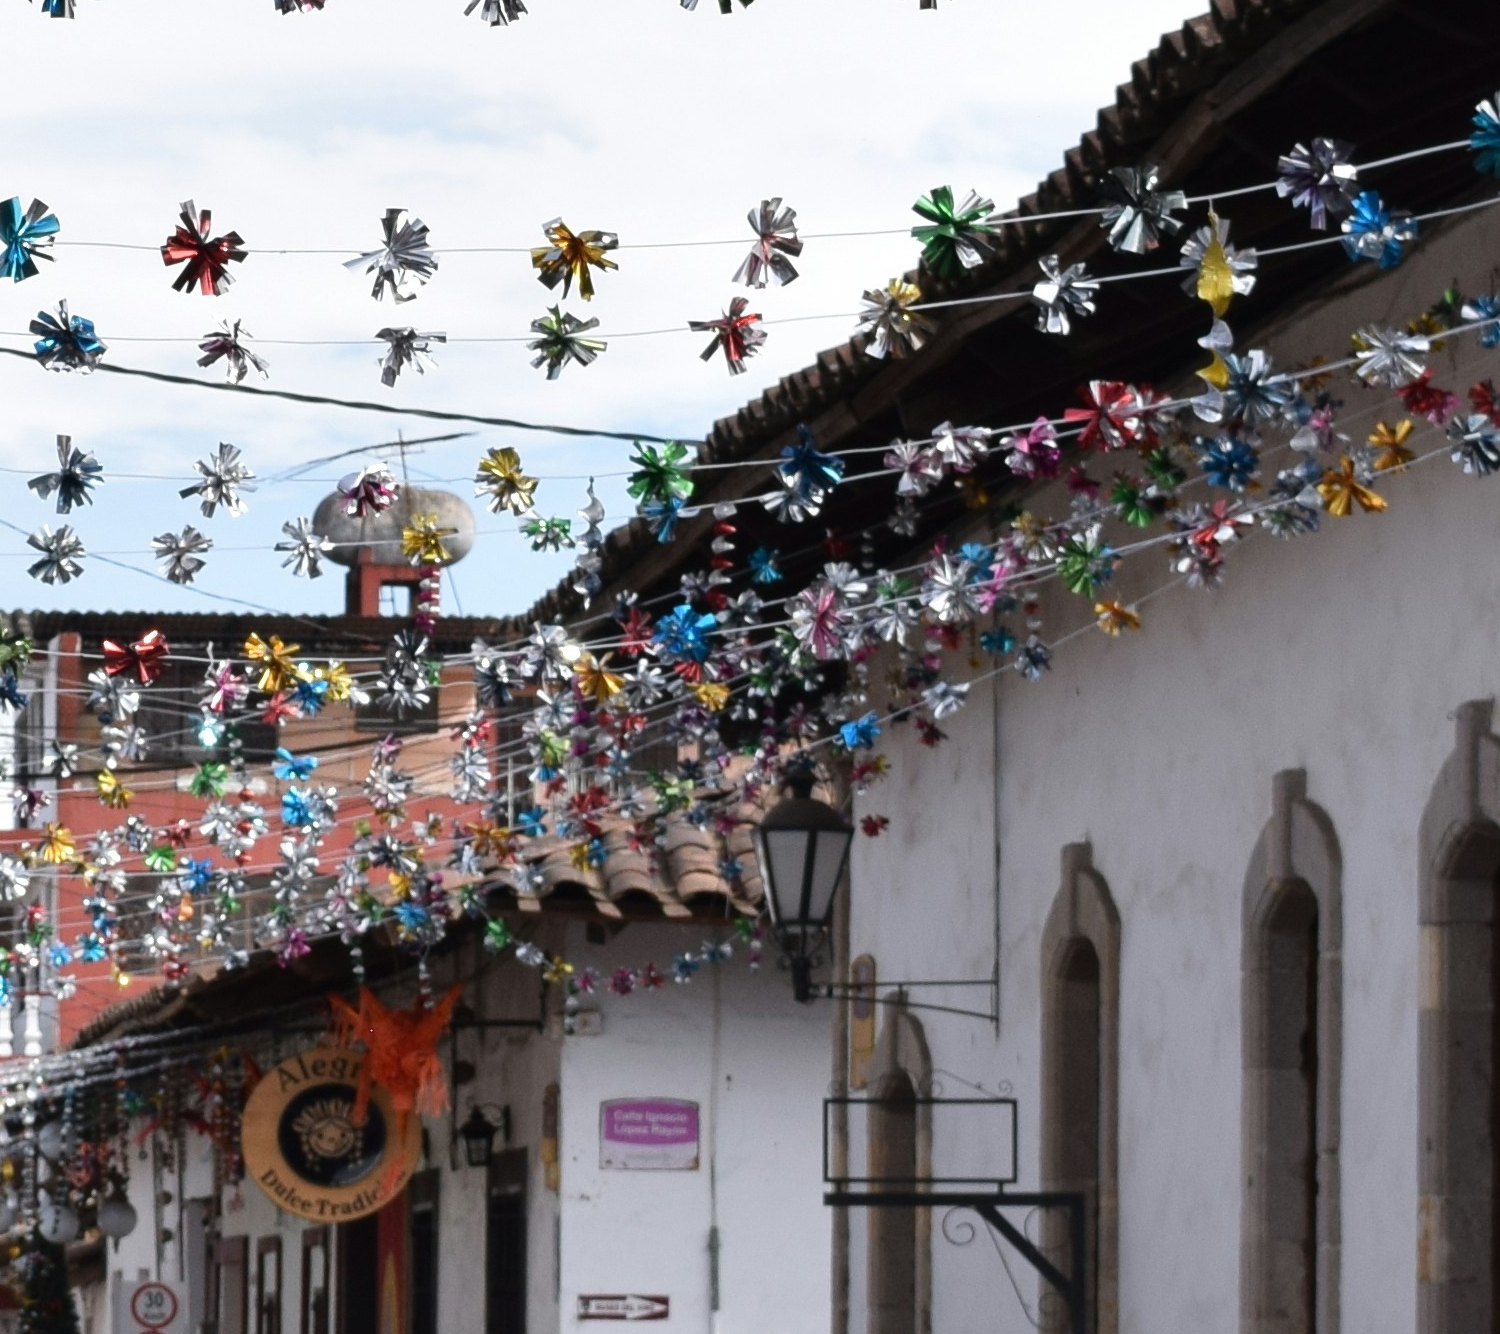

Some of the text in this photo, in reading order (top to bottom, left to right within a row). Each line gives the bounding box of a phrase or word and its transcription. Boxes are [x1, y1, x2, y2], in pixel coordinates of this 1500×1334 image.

[277, 1054, 362, 1093] Alegr
[261, 1169, 312, 1211] Dulce
[145, 1291, 165, 1308] 30
